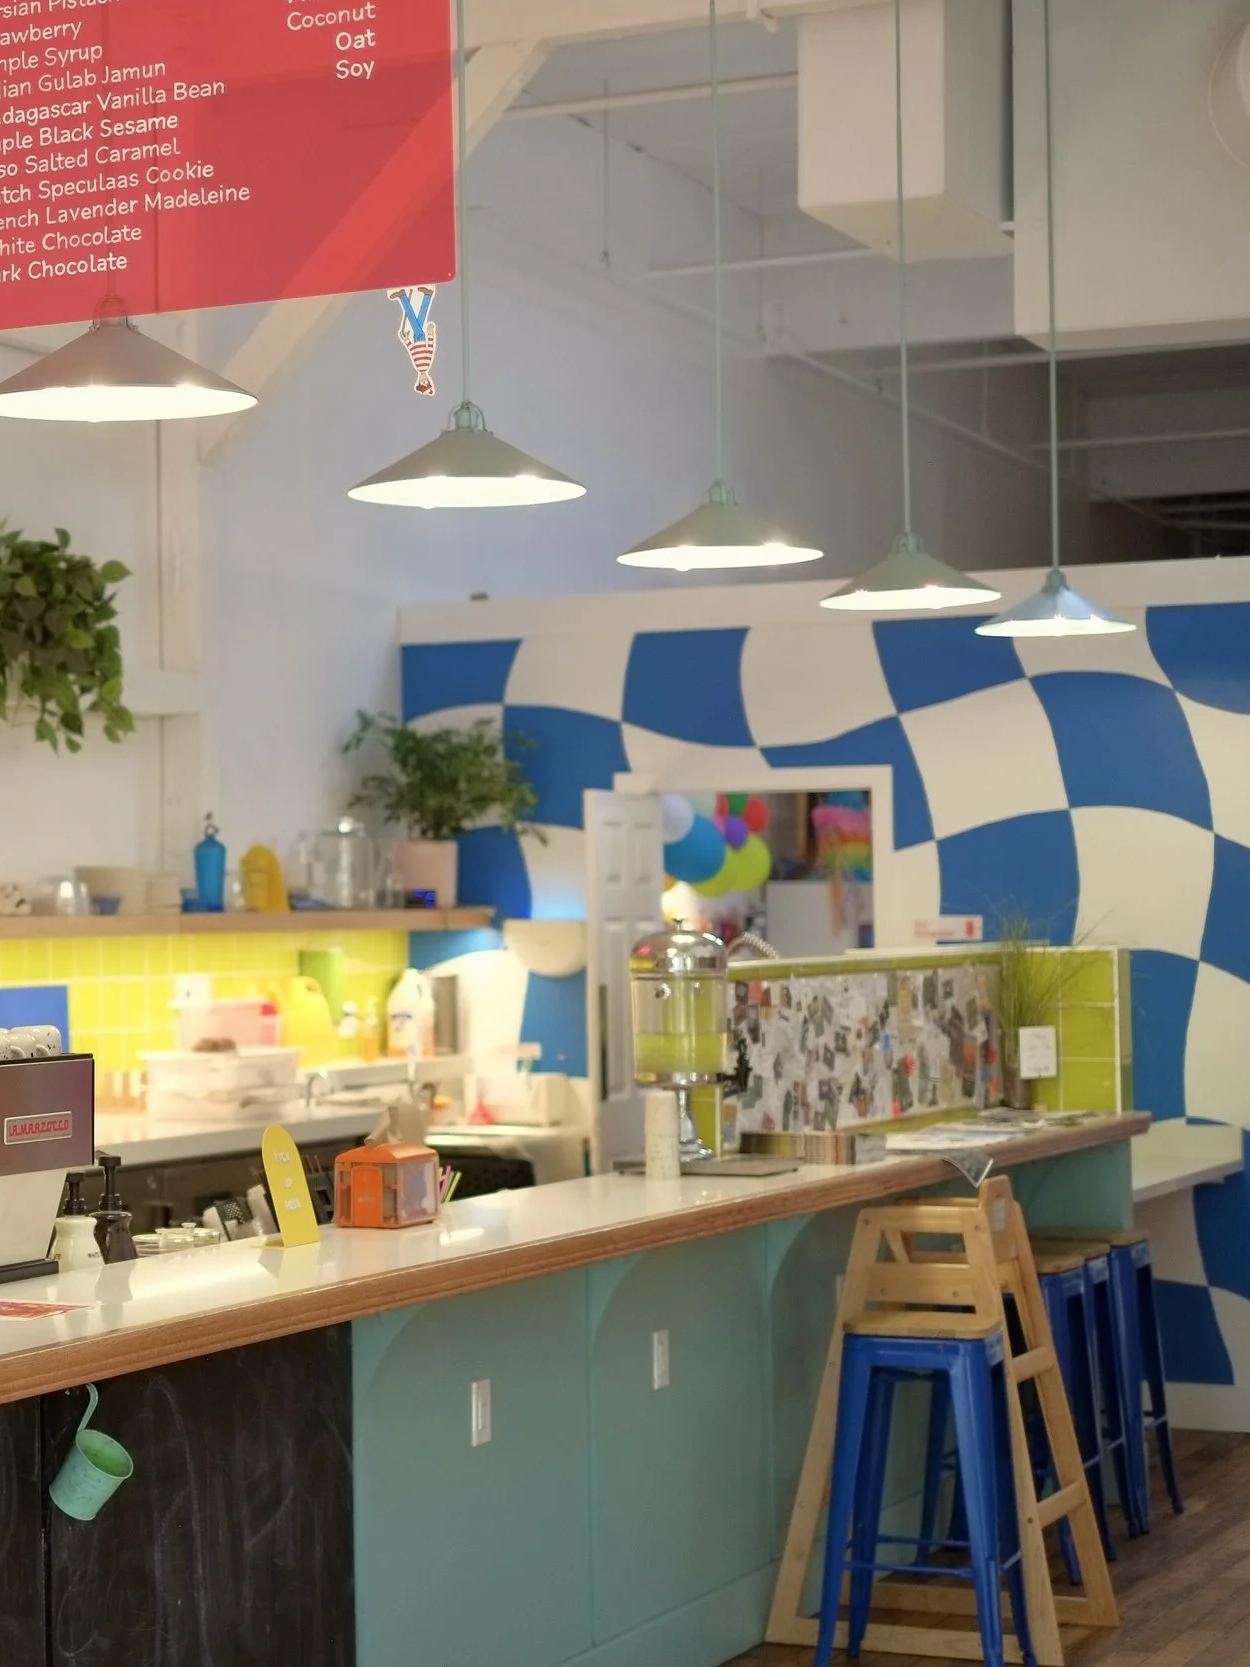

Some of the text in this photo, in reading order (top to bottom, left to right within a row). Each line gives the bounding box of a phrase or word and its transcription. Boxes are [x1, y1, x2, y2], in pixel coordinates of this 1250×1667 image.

[287, 1, 376, 31] Coconut
[335, 29, 376, 50] Oat
[44, 45, 103, 68] Syrup
[336, 59, 375, 79] Soy
[38, 68, 96, 92] Gulab
[102, 62, 166, 85] Jamun
[97, 86, 166, 112] Vanilla
[173, 81, 225, 101] Bean
[39, 123, 93, 146] Black
[100, 114, 178, 138] Sesame
[25, 148, 88, 174] Salted
[95, 137, 181, 164] Caramel
[38, 172, 139, 202] Speculaas
[146, 160, 215, 184] Cookie
[46, 197, 138, 225] Lavender
[144, 185, 251, 212] Madeleine
[42, 224, 143, 251] Chocolate
[28, 252, 128, 280] Chocolate
